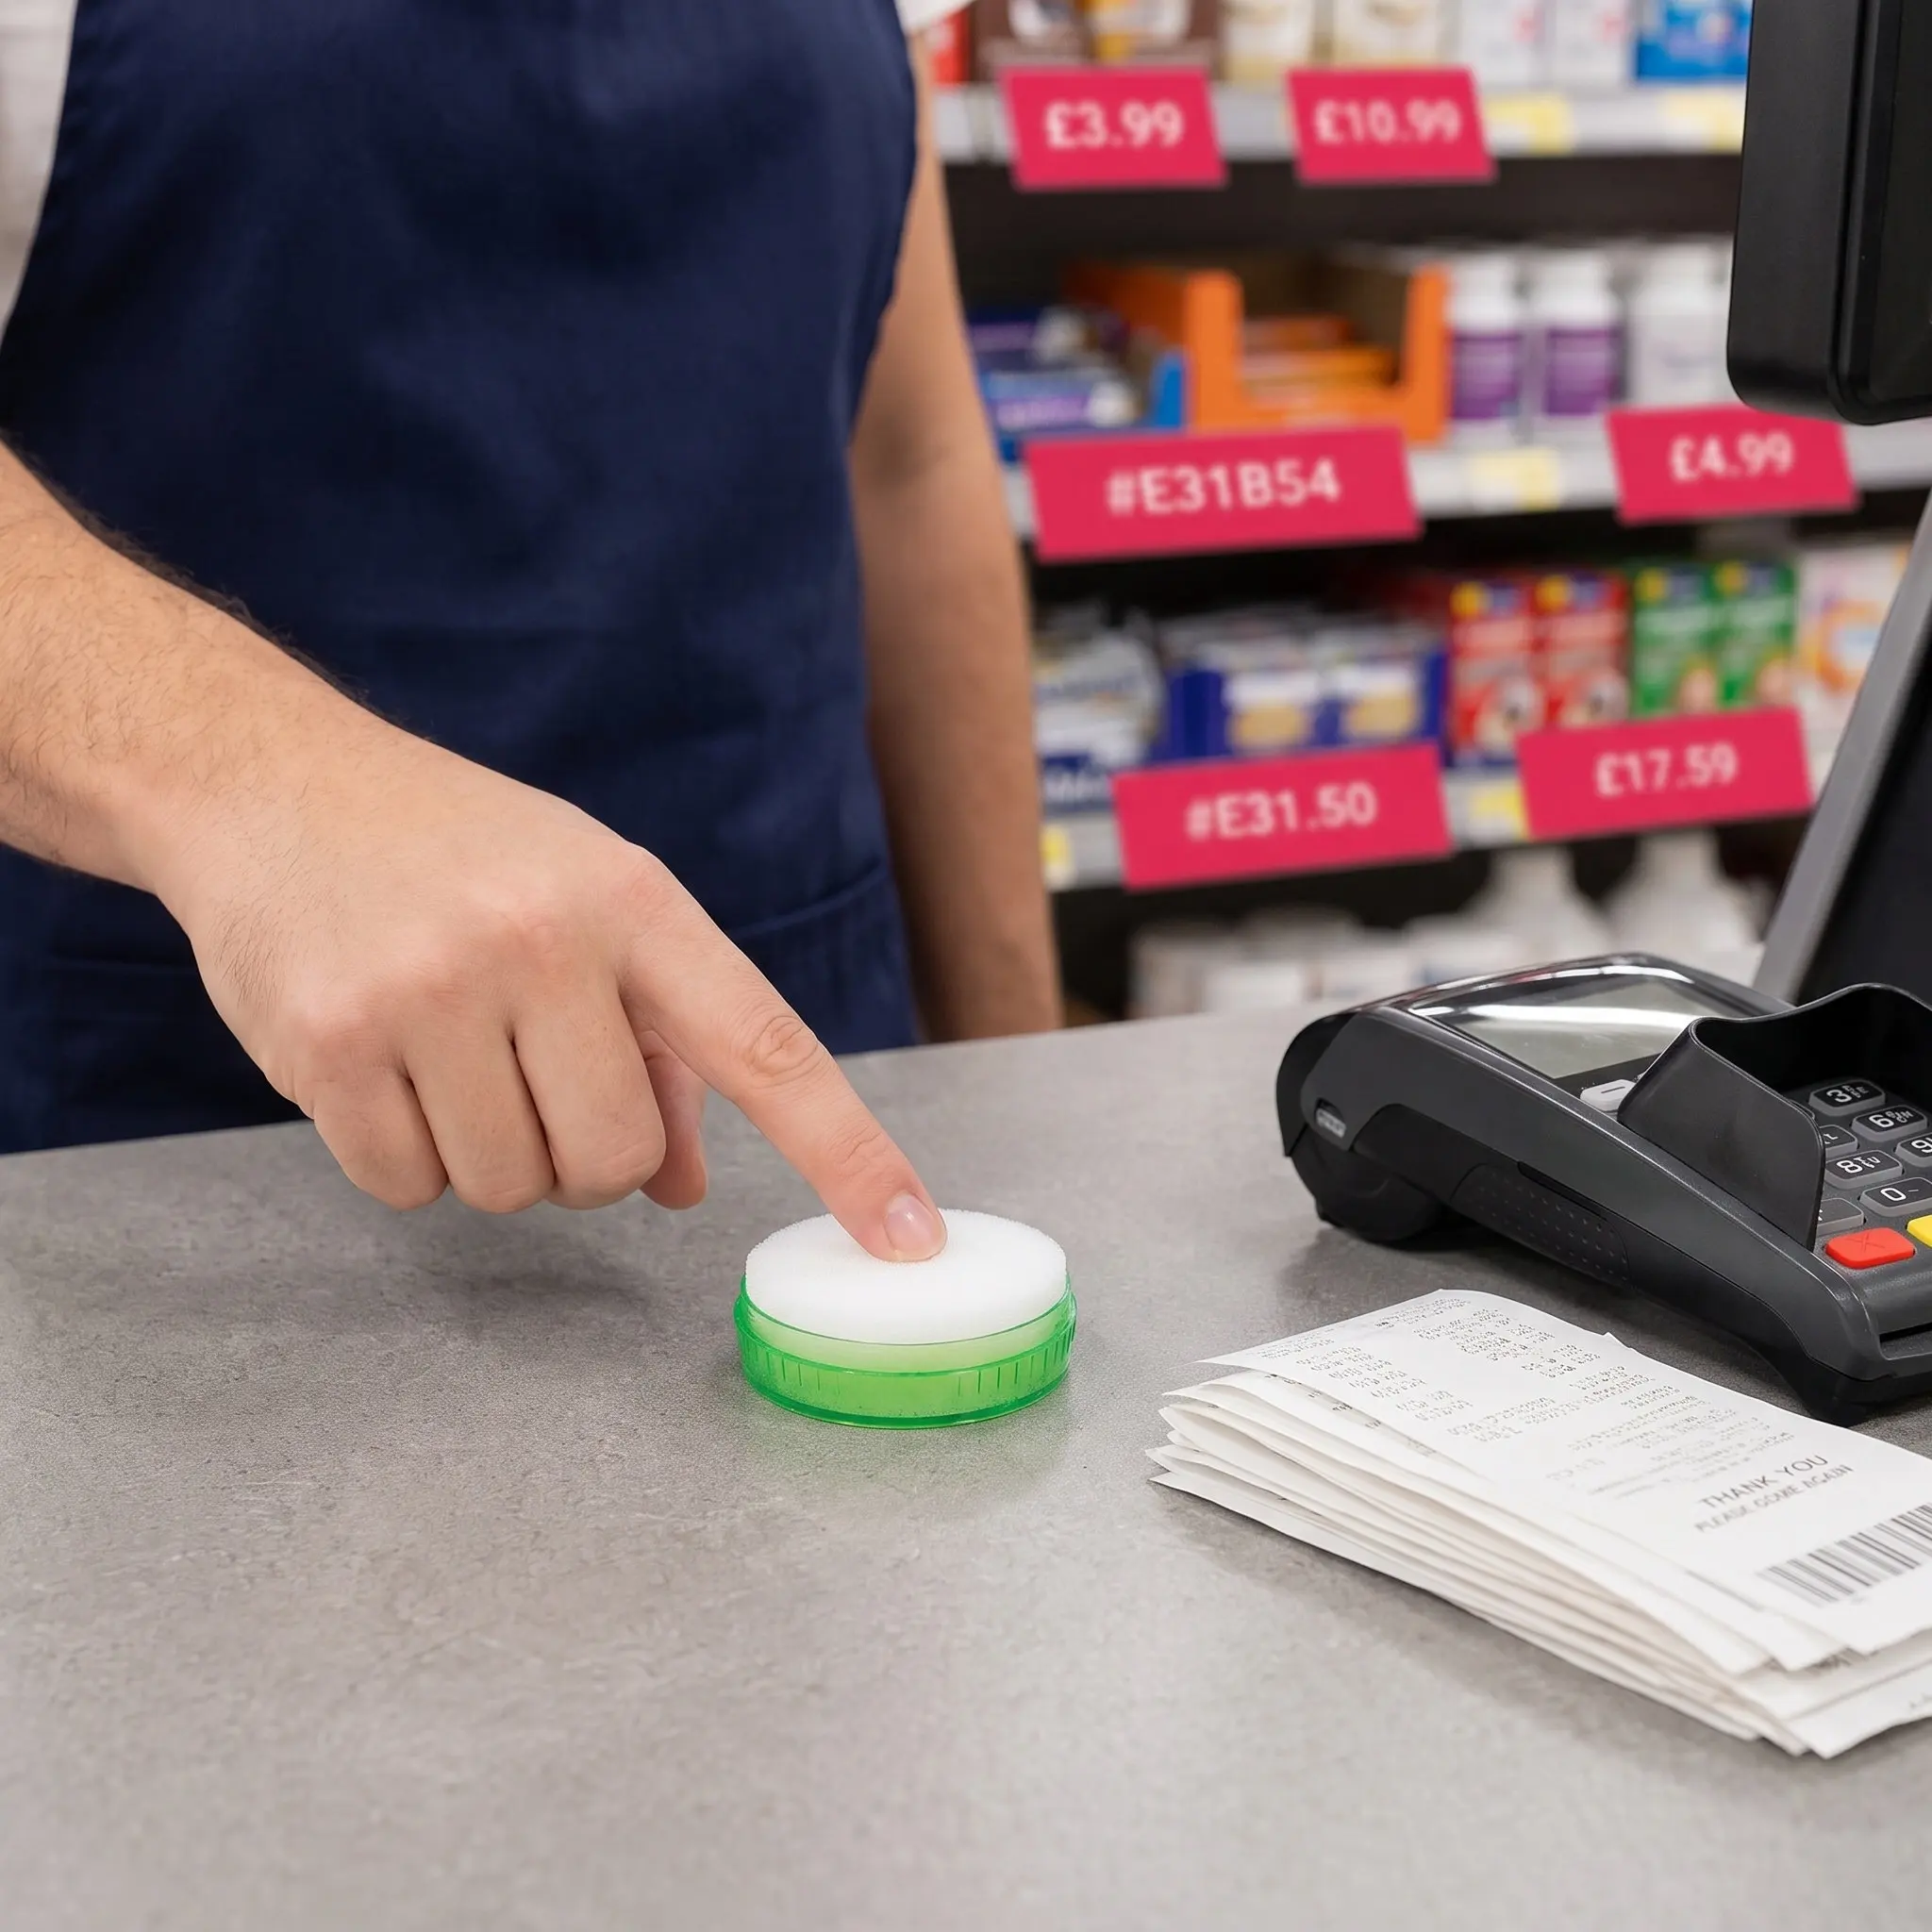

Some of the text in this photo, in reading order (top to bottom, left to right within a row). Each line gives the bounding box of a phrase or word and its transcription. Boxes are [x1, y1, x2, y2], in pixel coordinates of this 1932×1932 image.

[1045, 100, 1184, 147] £3.99
[1314, 99, 1461, 143] £10.99
[1669, 434, 1796, 482] £4.99
[1107, 458, 1341, 514] #E31B54
[1593, 742, 1740, 796] £17.59
[1185, 781, 1378, 841] #E31.50
[1826, 1089, 1853, 1103] 3
[1868, 1114, 1895, 1128] 6
[1836, 1159, 1863, 1174] 8
[1698, 1455, 1829, 1508] THANK YOU
